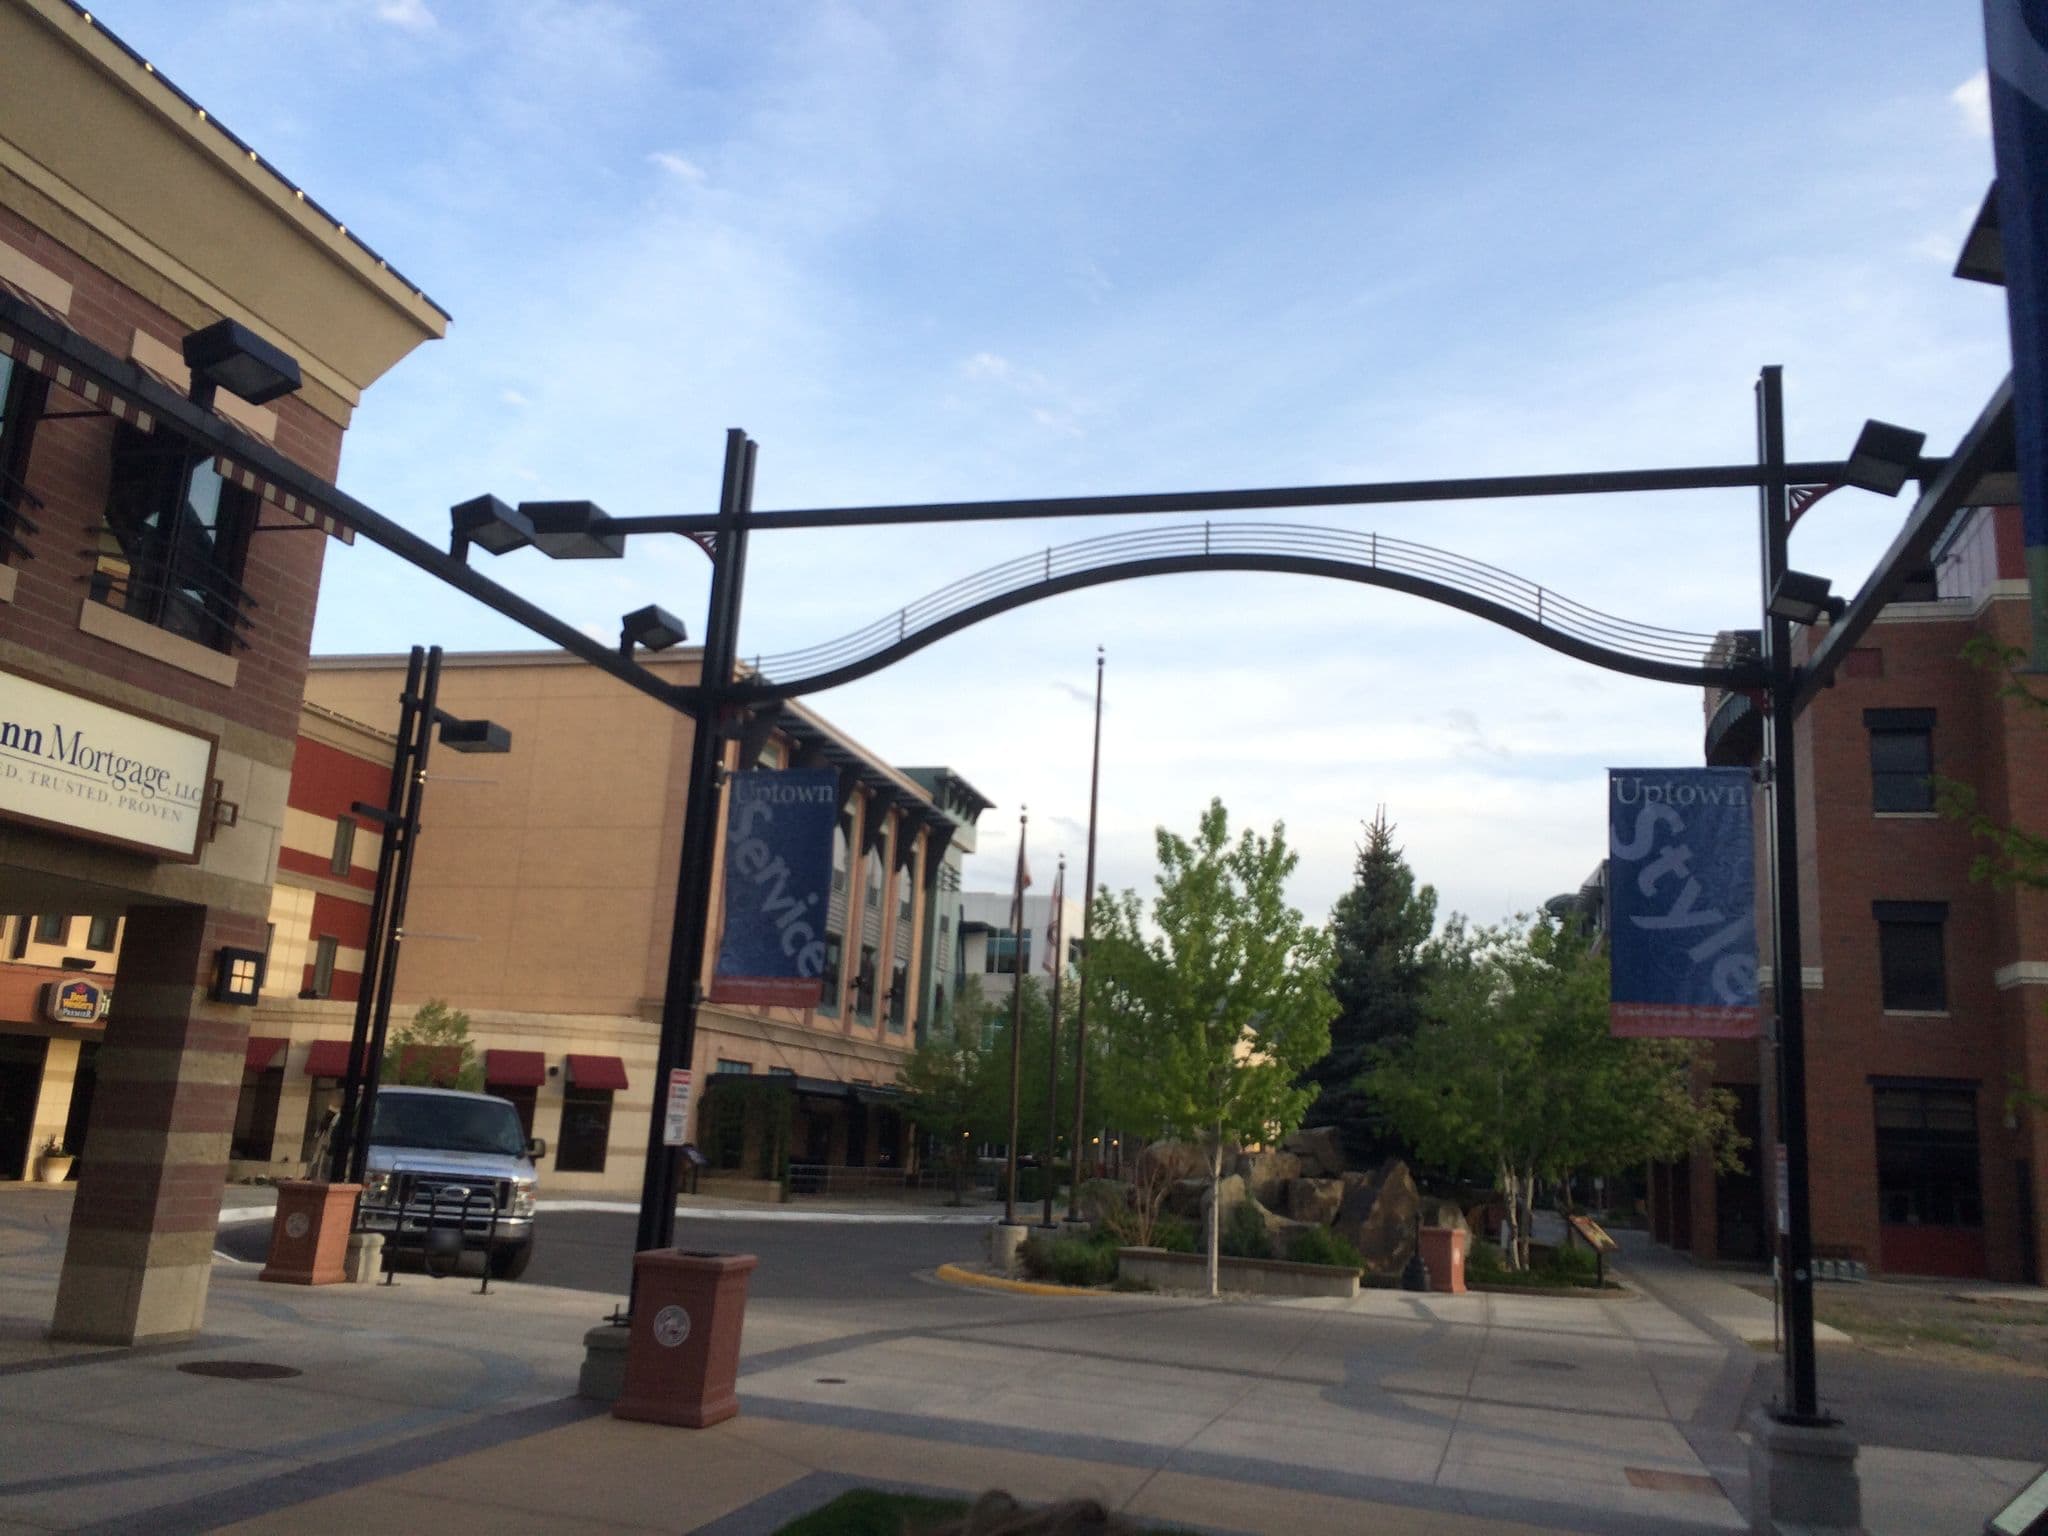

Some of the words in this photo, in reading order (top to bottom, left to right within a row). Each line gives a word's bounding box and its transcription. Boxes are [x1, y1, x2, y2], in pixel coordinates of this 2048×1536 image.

[175, 782, 202, 802] LLC
[735, 780, 834, 804] Uptown
[1616, 776, 1748, 808] Uptown
[118, 795, 183, 823] PROVEN
[729, 800, 826, 977] Service
[1611, 803, 1755, 1005] Style
[62, 998, 94, 1011] Western
[70, 991, 88, 1003] Best
[62, 1008, 92, 1019] PREMIER
